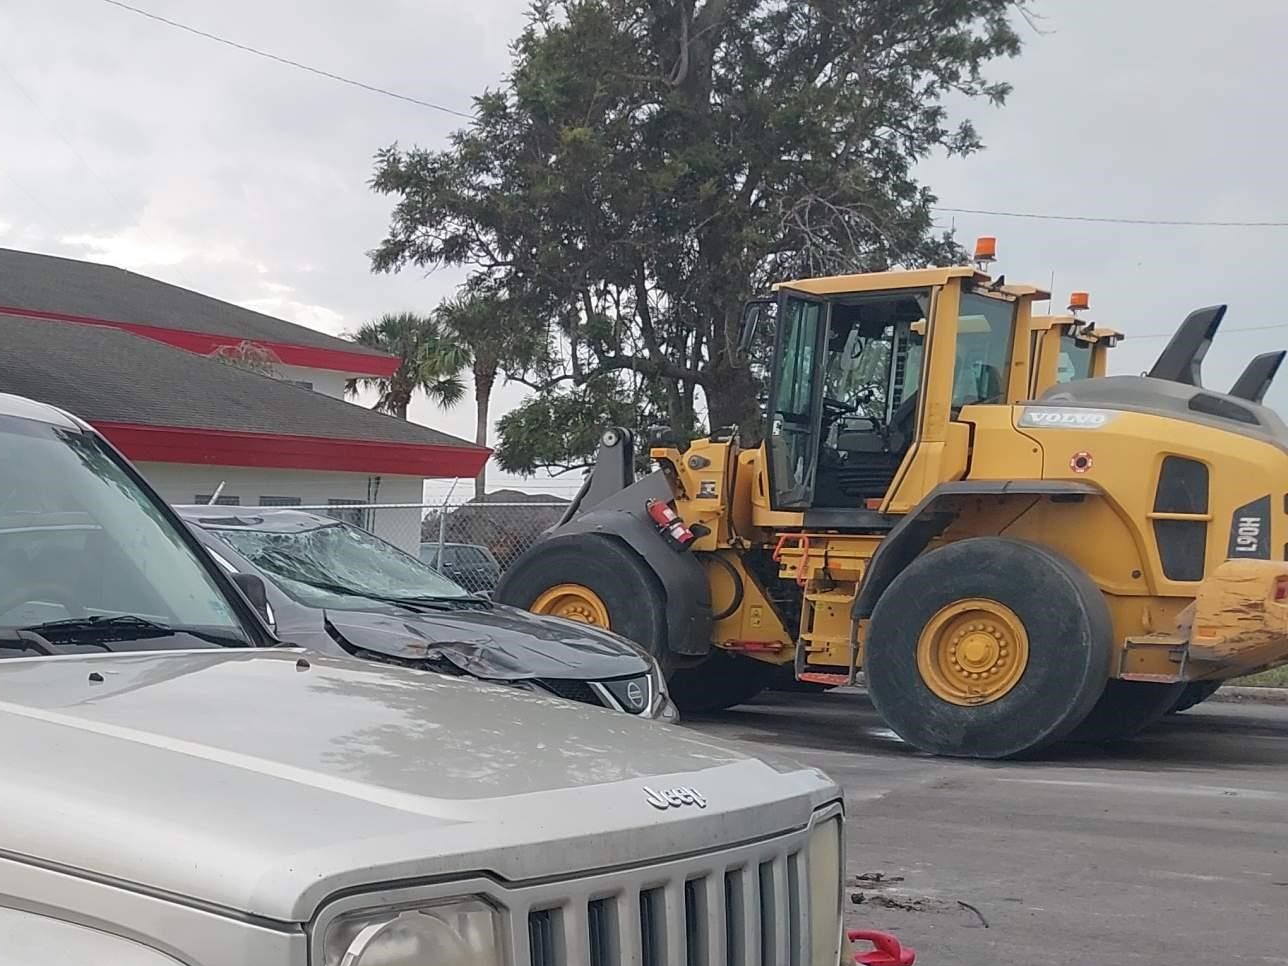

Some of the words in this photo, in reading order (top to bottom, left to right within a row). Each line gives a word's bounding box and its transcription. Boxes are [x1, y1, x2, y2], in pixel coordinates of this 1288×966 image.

[1030, 411, 1105, 424] VOLVO
[1235, 517, 1261, 551] L90H
[643, 785, 706, 810] Jeep
